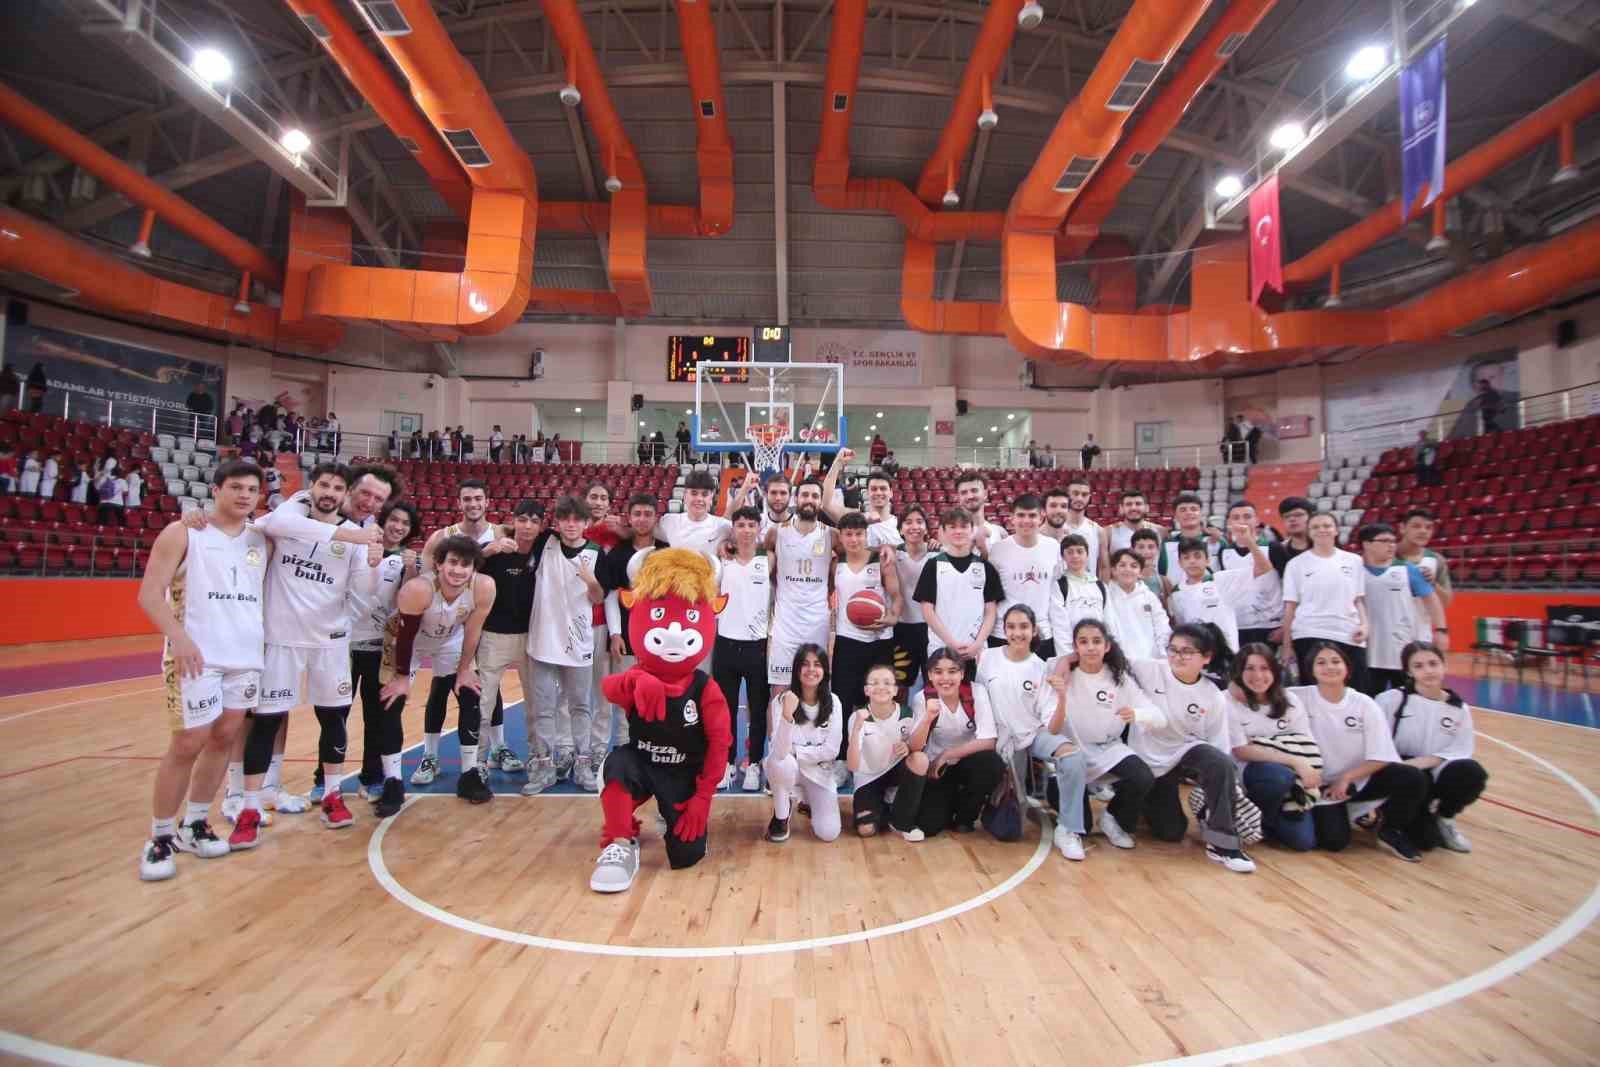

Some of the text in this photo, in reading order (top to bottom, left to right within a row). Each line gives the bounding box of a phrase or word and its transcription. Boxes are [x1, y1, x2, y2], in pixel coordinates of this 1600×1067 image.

[281, 553, 322, 571] pizza
[294, 566, 335, 585] bulls
[261, 687, 294, 699] LEVEL
[638, 739, 678, 755] pizza
